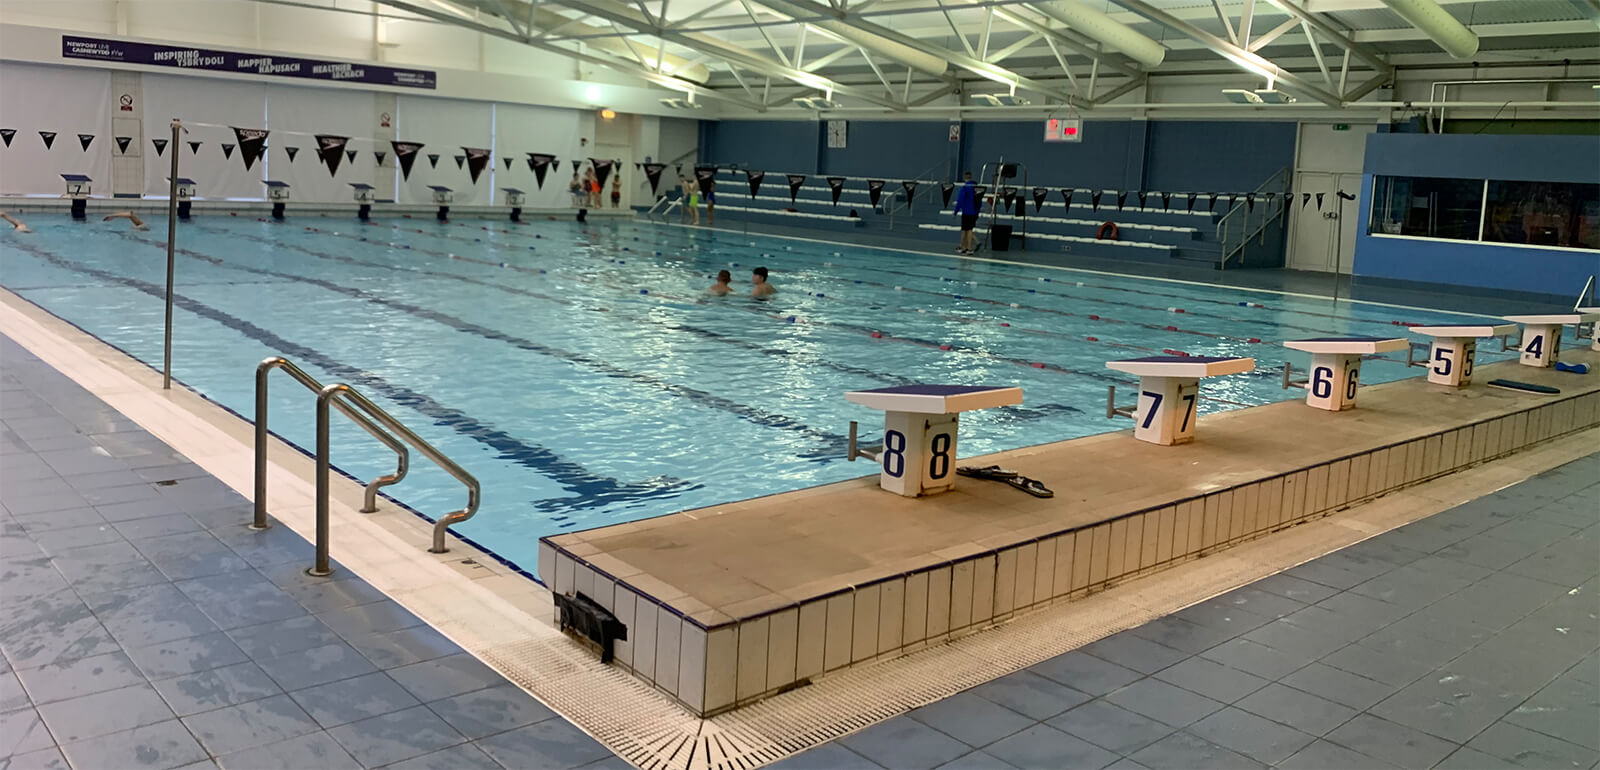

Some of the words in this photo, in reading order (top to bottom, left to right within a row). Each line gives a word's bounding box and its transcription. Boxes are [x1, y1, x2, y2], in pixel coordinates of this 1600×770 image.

[66, 41, 97, 49] NEWPORT
[154, 50, 199, 61] INSPIRING
[237, 58, 273, 68] HAPPIER
[258, 63, 301, 73] HAPUSACH
[312, 63, 352, 74] HEALTHIER
[239, 129, 267, 138] speedo
[74, 185, 82, 196] 7
[179, 187, 187, 198] 6
[274, 190, 281, 199] 5
[1525, 334, 1544, 359] 4
[1434, 347, 1454, 376] 5
[1464, 349, 1474, 377] 5
[1312, 366, 1333, 399] 6
[1346, 368, 1359, 400] 6
[1141, 390, 1163, 429] 7
[1180, 393, 1196, 433] 7
[883, 429, 906, 478] 8
[929, 432, 951, 480] 8
